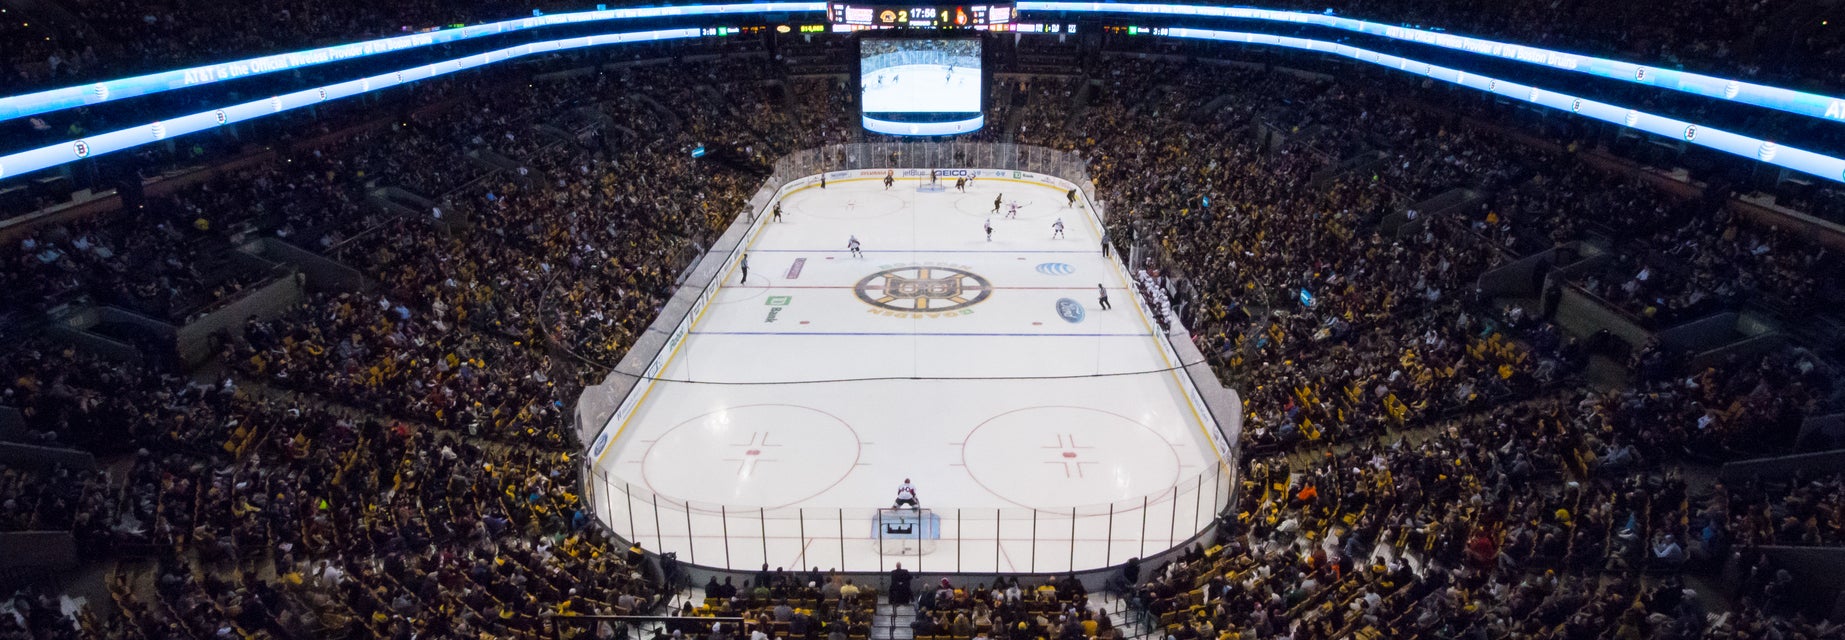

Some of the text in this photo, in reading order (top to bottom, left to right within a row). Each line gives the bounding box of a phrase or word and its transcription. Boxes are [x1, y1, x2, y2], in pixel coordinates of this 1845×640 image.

[898, 11, 907, 22] 2
[941, 11, 948, 22] 1
[1463, 38, 1493, 53] Provider
[1493, 43, 1502, 55] of
[1502, 45, 1517, 57] the
[1517, 47, 1546, 63] Boston
[1547, 52, 1577, 69] Bruins
[184, 67, 215, 85] AT&T
[217, 67, 228, 78] is
[229, 63, 249, 76] the
[250, 56, 288, 72] Official
[289, 50, 328, 66] Wireless
[329, 46, 363, 60] Provider
[903, 169, 926, 177] jetBlue
[764, 307, 782, 322] Bank
